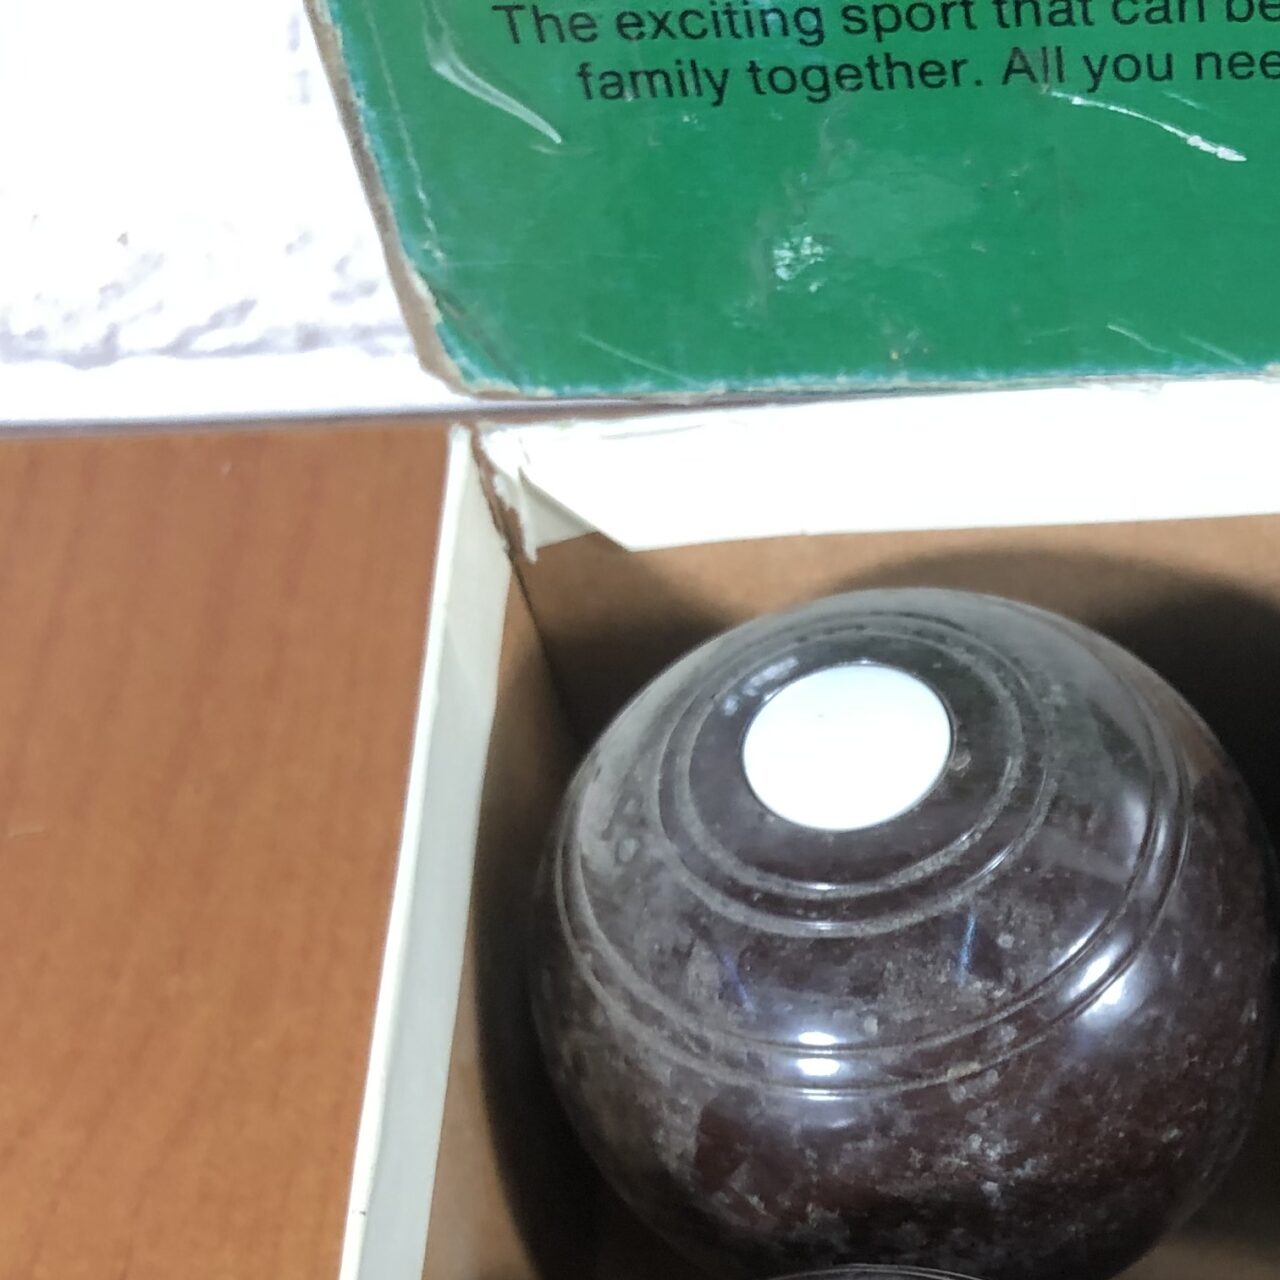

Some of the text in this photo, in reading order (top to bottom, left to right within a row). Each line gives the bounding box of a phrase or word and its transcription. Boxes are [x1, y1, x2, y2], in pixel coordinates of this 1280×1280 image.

[491, 4, 598, 44] The
[615, 1, 826, 47] exciting
[840, 0, 977, 43] sport
[991, 0, 1094, 29] that
[1111, 0, 1206, 26] can
[576, 59, 730, 107] family
[746, 52, 983, 104] together.
[1001, 45, 1065, 86] All
[1082, 52, 1173, 94] you
